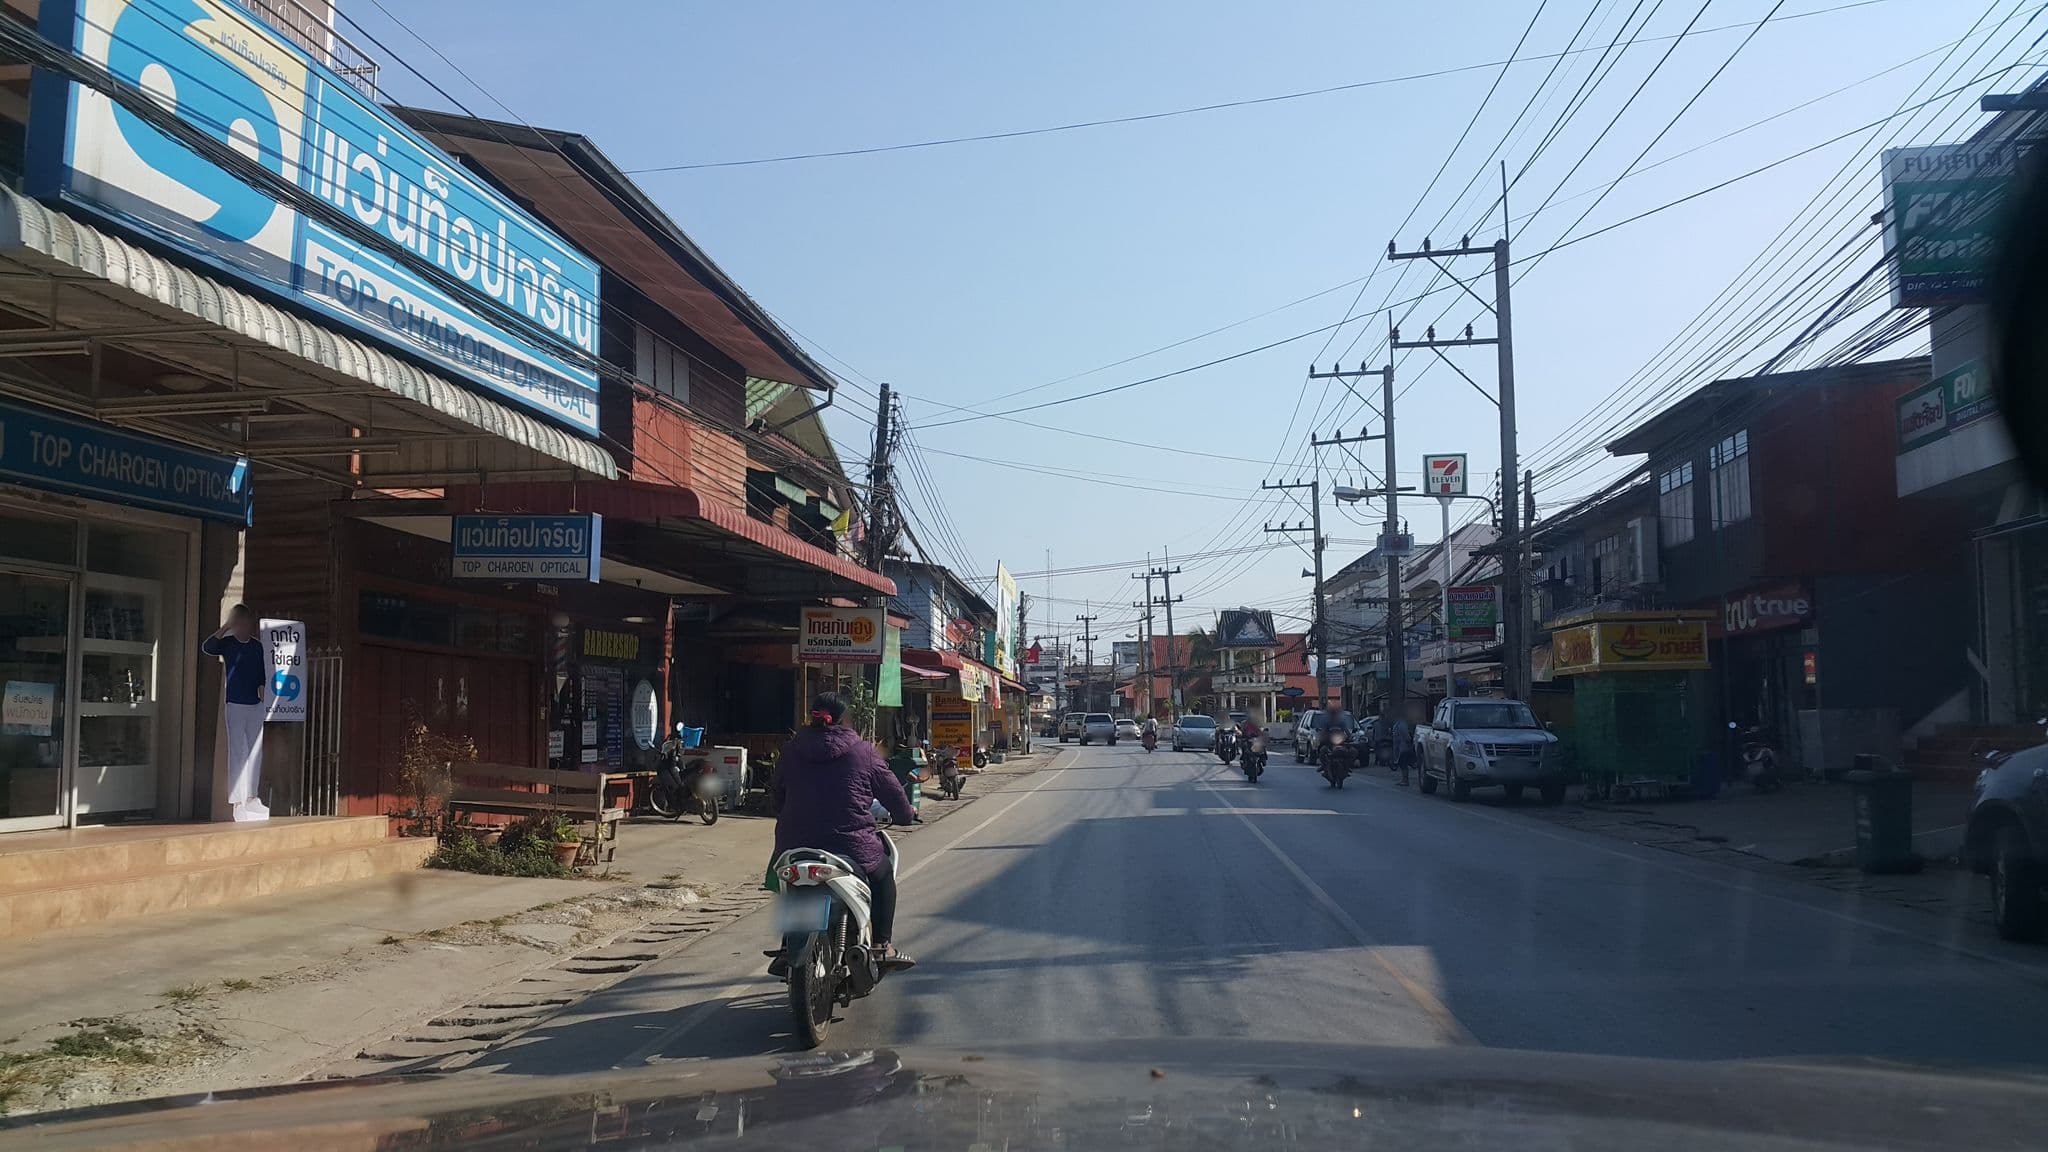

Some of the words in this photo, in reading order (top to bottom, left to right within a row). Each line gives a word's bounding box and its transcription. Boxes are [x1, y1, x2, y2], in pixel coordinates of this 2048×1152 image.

[318, 127, 597, 350] แว่นท็อปเจริญ
[317, 255, 377, 308] TOP
[389, 294, 502, 378] CHAROEN
[514, 352, 592, 419] OPTICAL
[30, 430, 72, 468] TOP
[79, 443, 168, 489] CHAROEN
[173, 464, 241, 504] OPTICAL
[461, 518, 584, 554] แว่นท็อปเจริญ
[462, 561, 481, 573] TOP
[487, 561, 534, 573] CHAROEN
[539, 561, 581, 574] OPTICAL
[1753, 595, 1809, 617] true
[271, 626, 300, 647] ถูกใจ
[808, 617, 872, 634] ไทยกันเอง
[584, 628, 639, 660] BARBERSHOP
[271, 650, 301, 666] ใช่เลย
